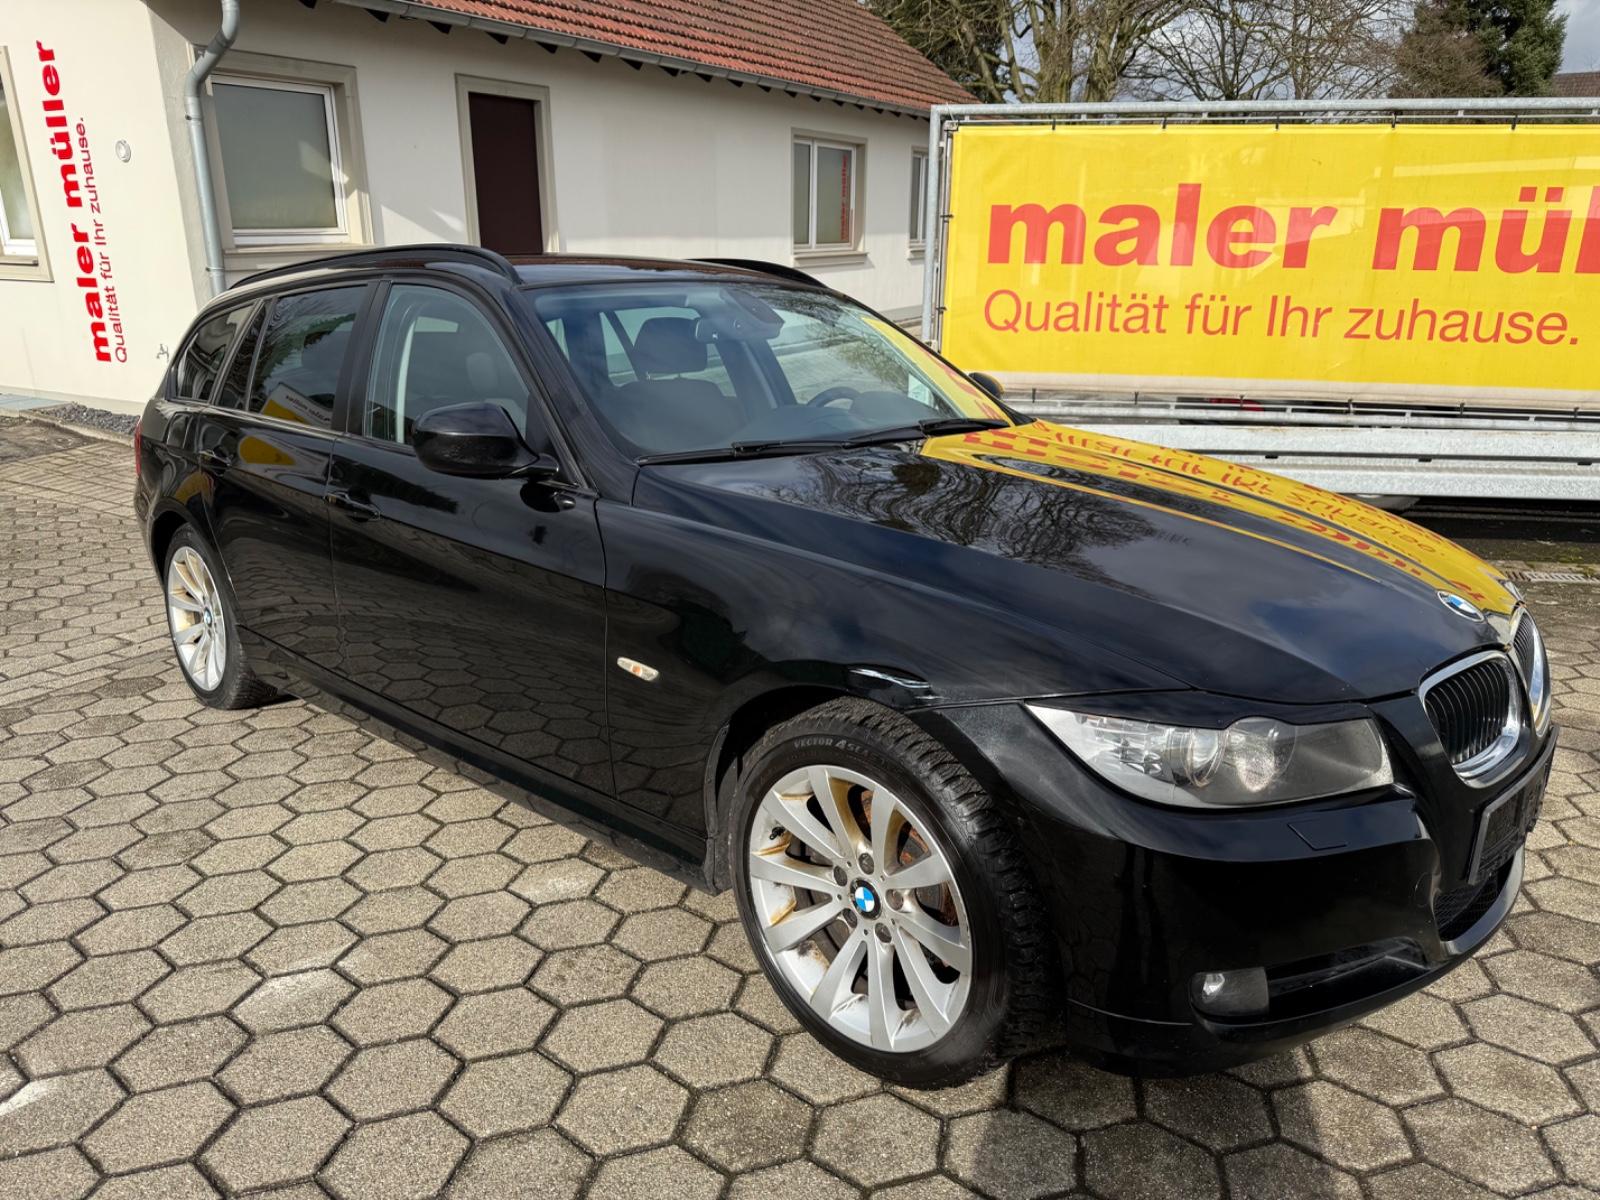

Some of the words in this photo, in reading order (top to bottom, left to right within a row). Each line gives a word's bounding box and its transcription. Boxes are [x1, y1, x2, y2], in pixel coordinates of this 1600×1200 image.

[36, 40, 83, 209] müller
[76, 117, 102, 214] zuhause.
[94, 219, 107, 247] Ihr
[100, 251, 113, 280] für
[988, 184, 1337, 268] maler
[70, 223, 112, 362] maler
[104, 286, 127, 363] Qualität
[984, 289, 1169, 333] Qualität
[1185, 293, 1252, 336] für
[1266, 295, 1333, 338] Ihr
[1344, 298, 1578, 345] zuhause.
